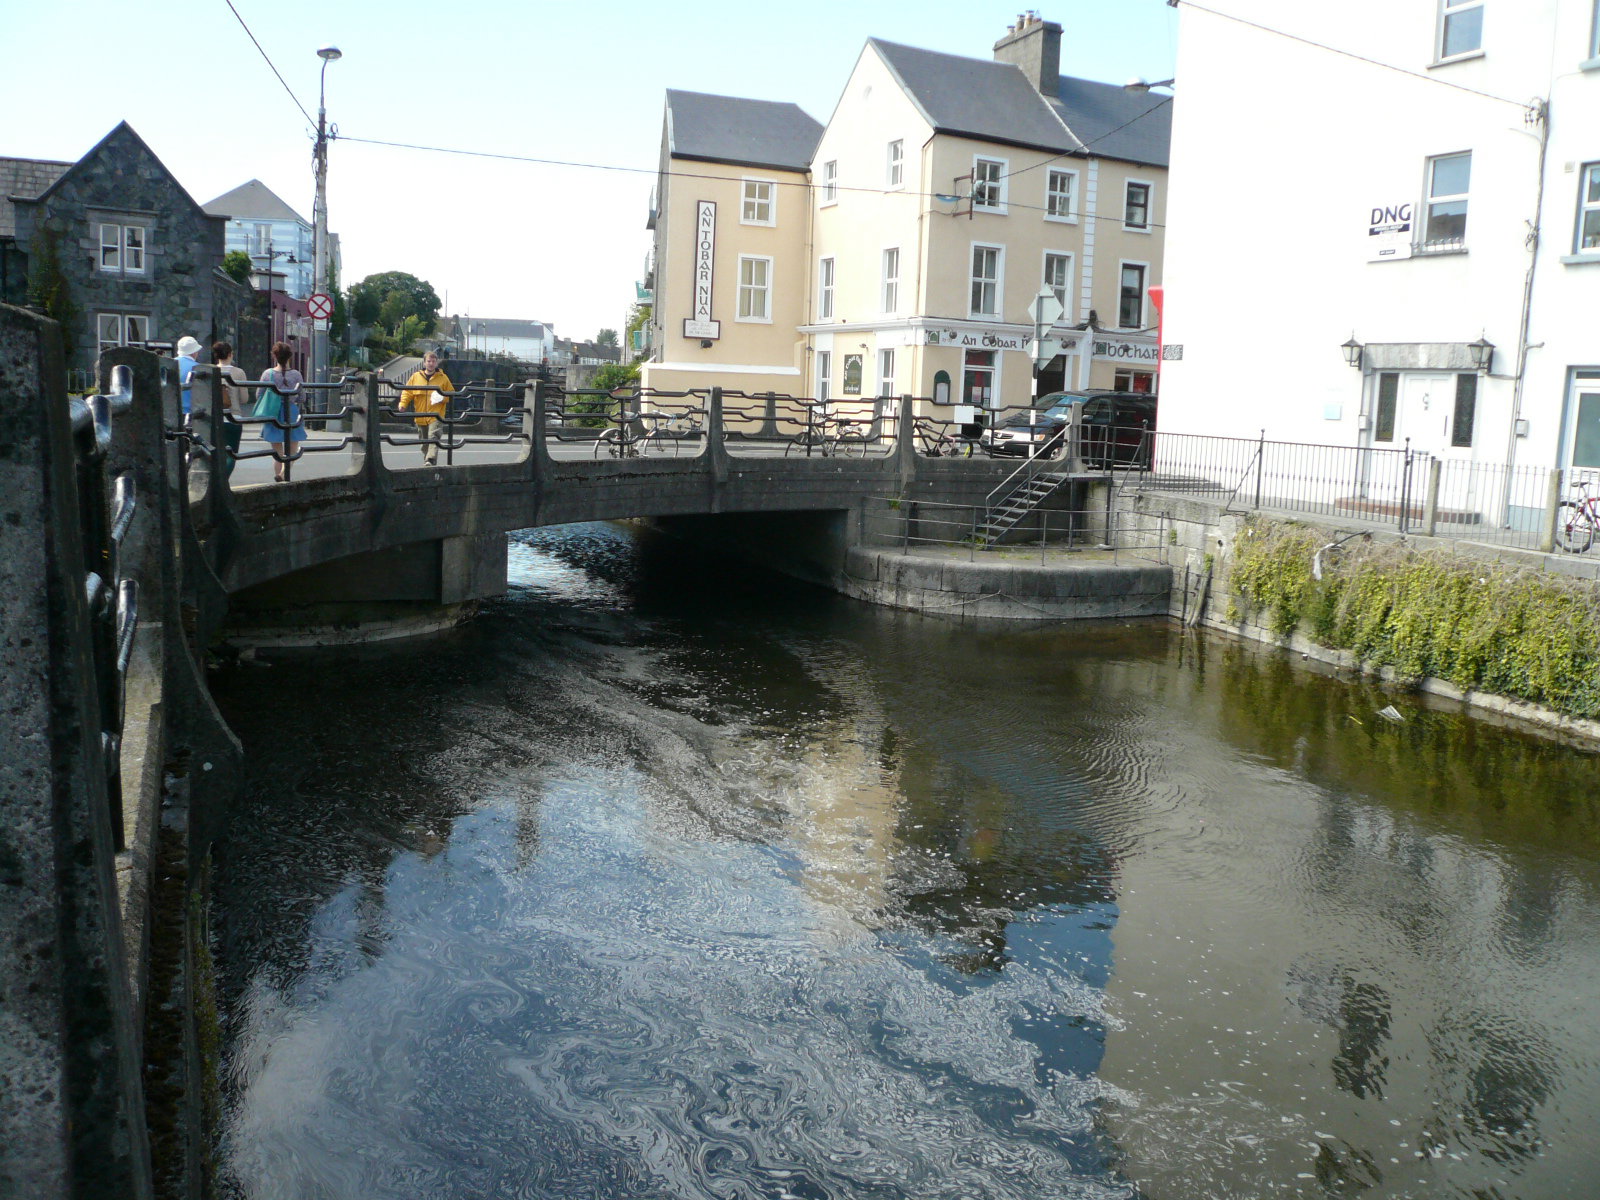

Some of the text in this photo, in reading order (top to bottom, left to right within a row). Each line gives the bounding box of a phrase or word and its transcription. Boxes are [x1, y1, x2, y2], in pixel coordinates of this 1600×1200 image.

[701, 206, 713, 227] AN
[1370, 203, 1411, 226] DNG
[699, 230, 711, 281] TOBAR
[698, 285, 709, 316] NUA
